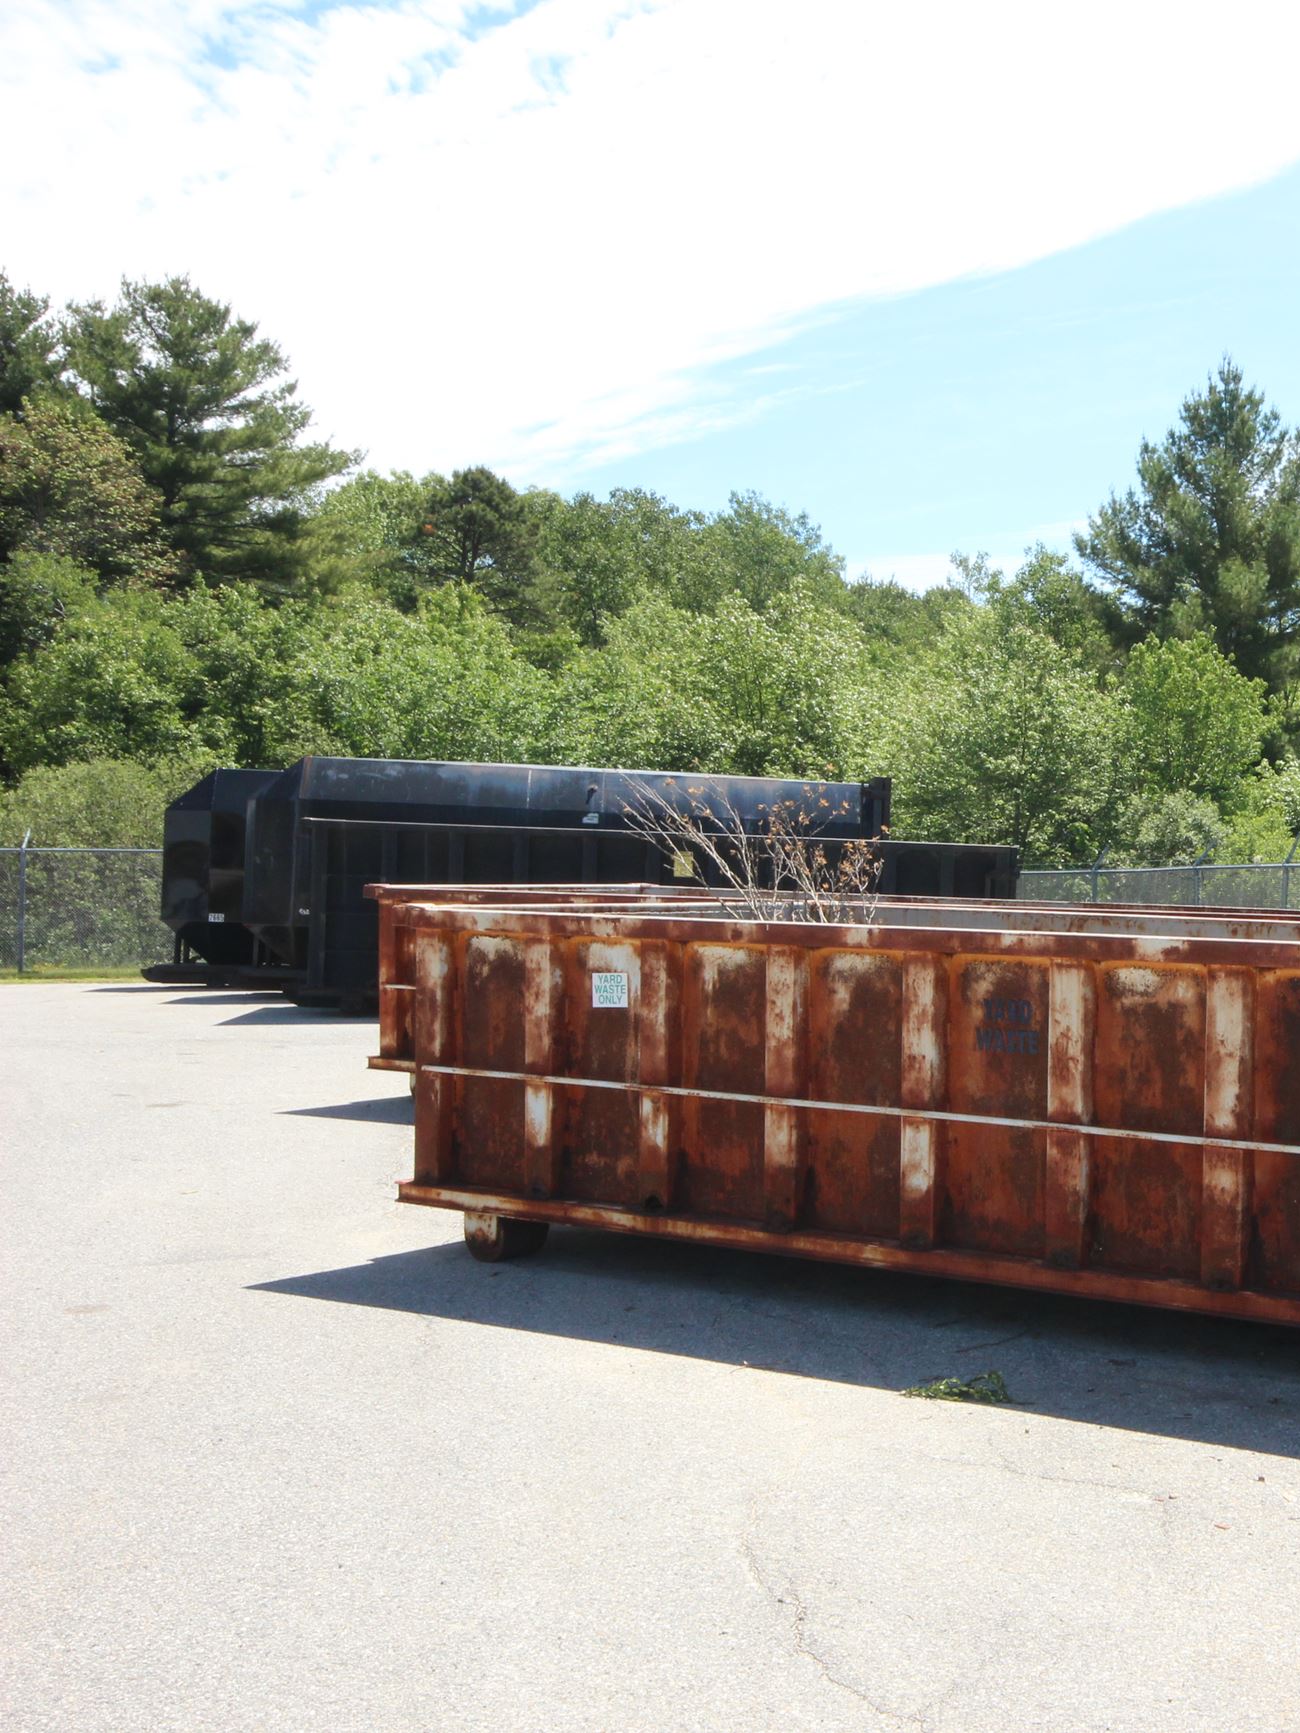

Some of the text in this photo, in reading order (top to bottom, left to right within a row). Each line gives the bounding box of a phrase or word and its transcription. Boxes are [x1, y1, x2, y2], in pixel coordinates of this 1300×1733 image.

[598, 975, 622, 984] YARD
[595, 985, 626, 994] WASTE
[598, 995, 622, 1004] ONLY
[976, 1027, 1039, 1054] WASTE
